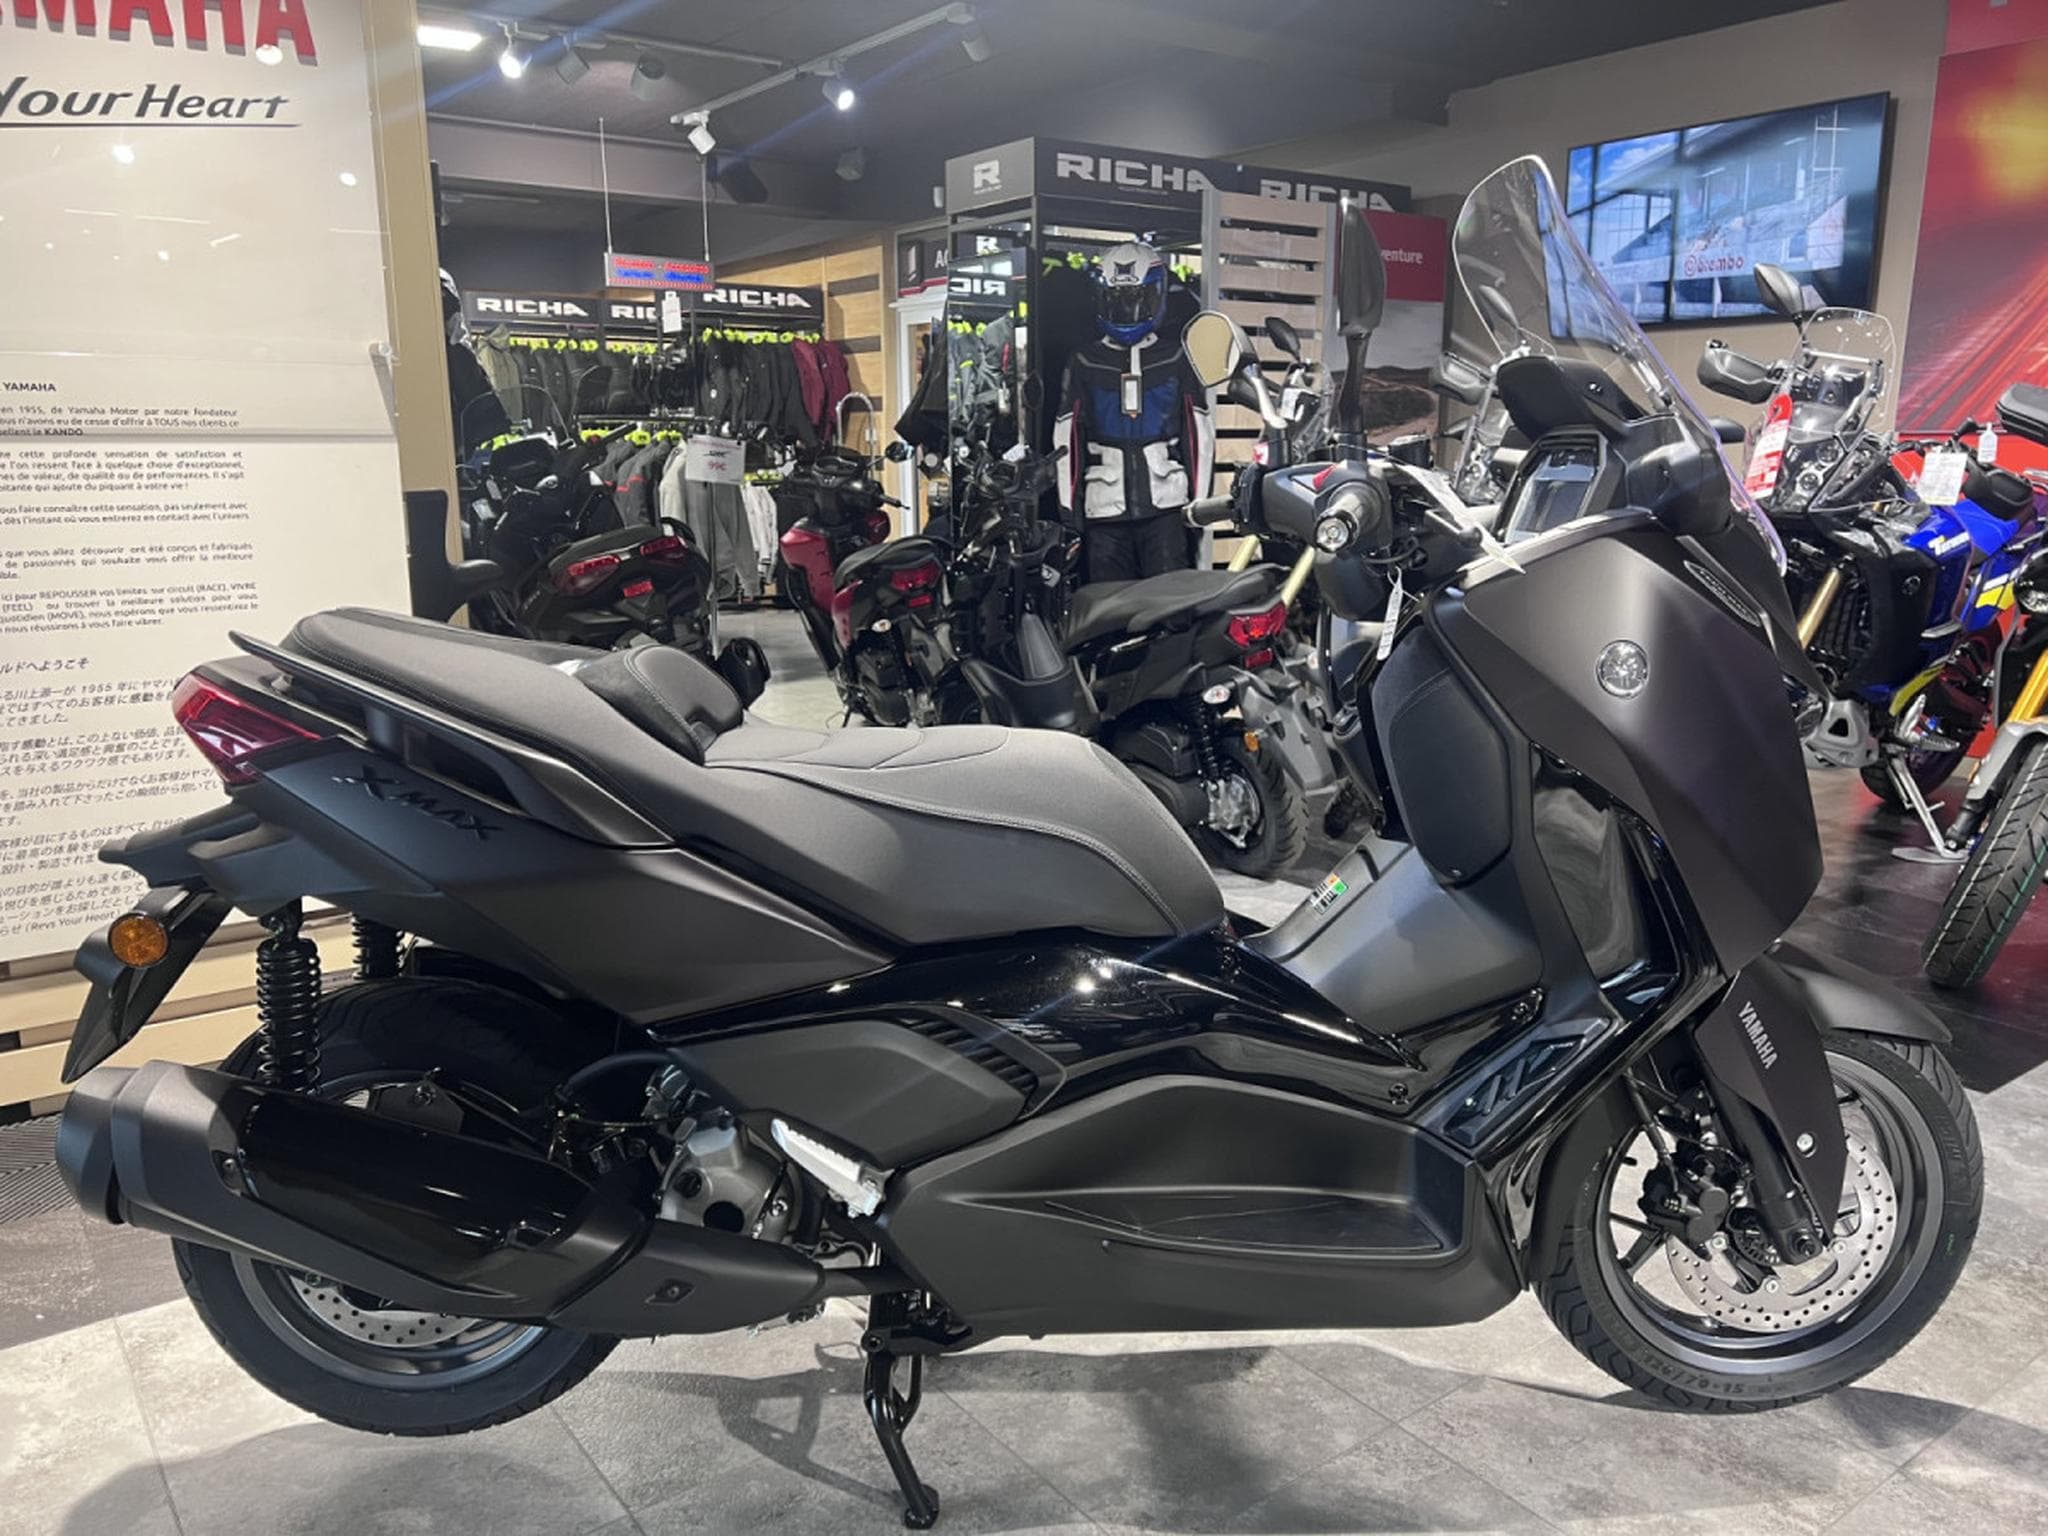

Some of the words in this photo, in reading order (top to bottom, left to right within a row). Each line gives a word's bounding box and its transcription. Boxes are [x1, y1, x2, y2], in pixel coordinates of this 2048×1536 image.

[135, 84, 288, 119] Heart
[702, 285, 811, 309] RICHA
[477, 298, 588, 317] RICHA
[3, 382, 57, 392] YAMAHA
[51, 406, 62, 414] de
[68, 407, 106, 415] Yamaha
[110, 407, 139, 415] Motor
[144, 409, 160, 417] par
[164, 408, 189, 416] notre
[194, 407, 238, 417] fondateur
[71, 418, 83, 426] de
[153, 418, 180, 426] TOUS
[44, 428, 84, 436] KANDO
[19, 450, 45, 459] cette
[52, 450, 97, 461] profonde
[105, 450, 149, 459] sensation
[156, 450, 168, 458] de
[175, 450, 226, 459] satisfaction
[32, 462, 68, 470] ressent
[72, 461, 93, 470] face
[106, 461, 143, 471] quelque
[147, 460, 174, 469] chose
[17, 471, 29, 480] de
[68, 471, 79, 479] de
[82, 471, 116, 482] qualité
[133, 471, 144, 479] de
[35, 483, 50, 492] qui
[53, 482, 82, 492] ajoute
[84, 482, 97, 490] du
[99, 482, 134, 492] piquant
[144, 482, 168, 490] votre
[19, 505, 41, 514] faire
[43, 504, 88, 513] connaître
[90, 504, 114, 512] cette
[164, 504, 180, 512] pas
[181, 502, 226, 511] seulement
[102, 514, 140, 522] entrerez
[157, 513, 189, 521] contact
[5, 550, 24, 559] que
[53, 547, 75, 556] allez
[80, 546, 125, 555] découvrir
[149, 544, 164, 552] été
[212, 541, 253, 552] fabriqués
[5, 560, 18, 568] de
[23, 558, 76, 569] passionnés
[81, 557, 97, 567] qui
[102, 556, 140, 565] souhaite
[213, 552, 253, 561] meilleure
[15, 592, 37, 602] pour
[39, 588, 97, 600] REPOUSSER
[99, 589, 115, 597] vos
[166, 585, 195, 594] circuit
[231, 581, 257, 591] VIVRE
[65, 600, 100, 609] trouver
[106, 598, 116, 606] la
[121, 596, 164, 606] meilleure
[170, 595, 206, 604] solution
[211, 594, 232, 603] pour
[237, 592, 258, 600] vous
[114, 607, 156, 618] espérons
[158, 606, 175, 616] que
[177, 604, 199, 613] vous
[4, 624, 28, 633] nous
[31, 621, 80, 632] réussirons
[89, 619, 110, 628] vous
[112, 617, 134, 627] faire
[59, 915, 82, 927] Your
[1738, 1000, 1778, 1070] YAMAHA
